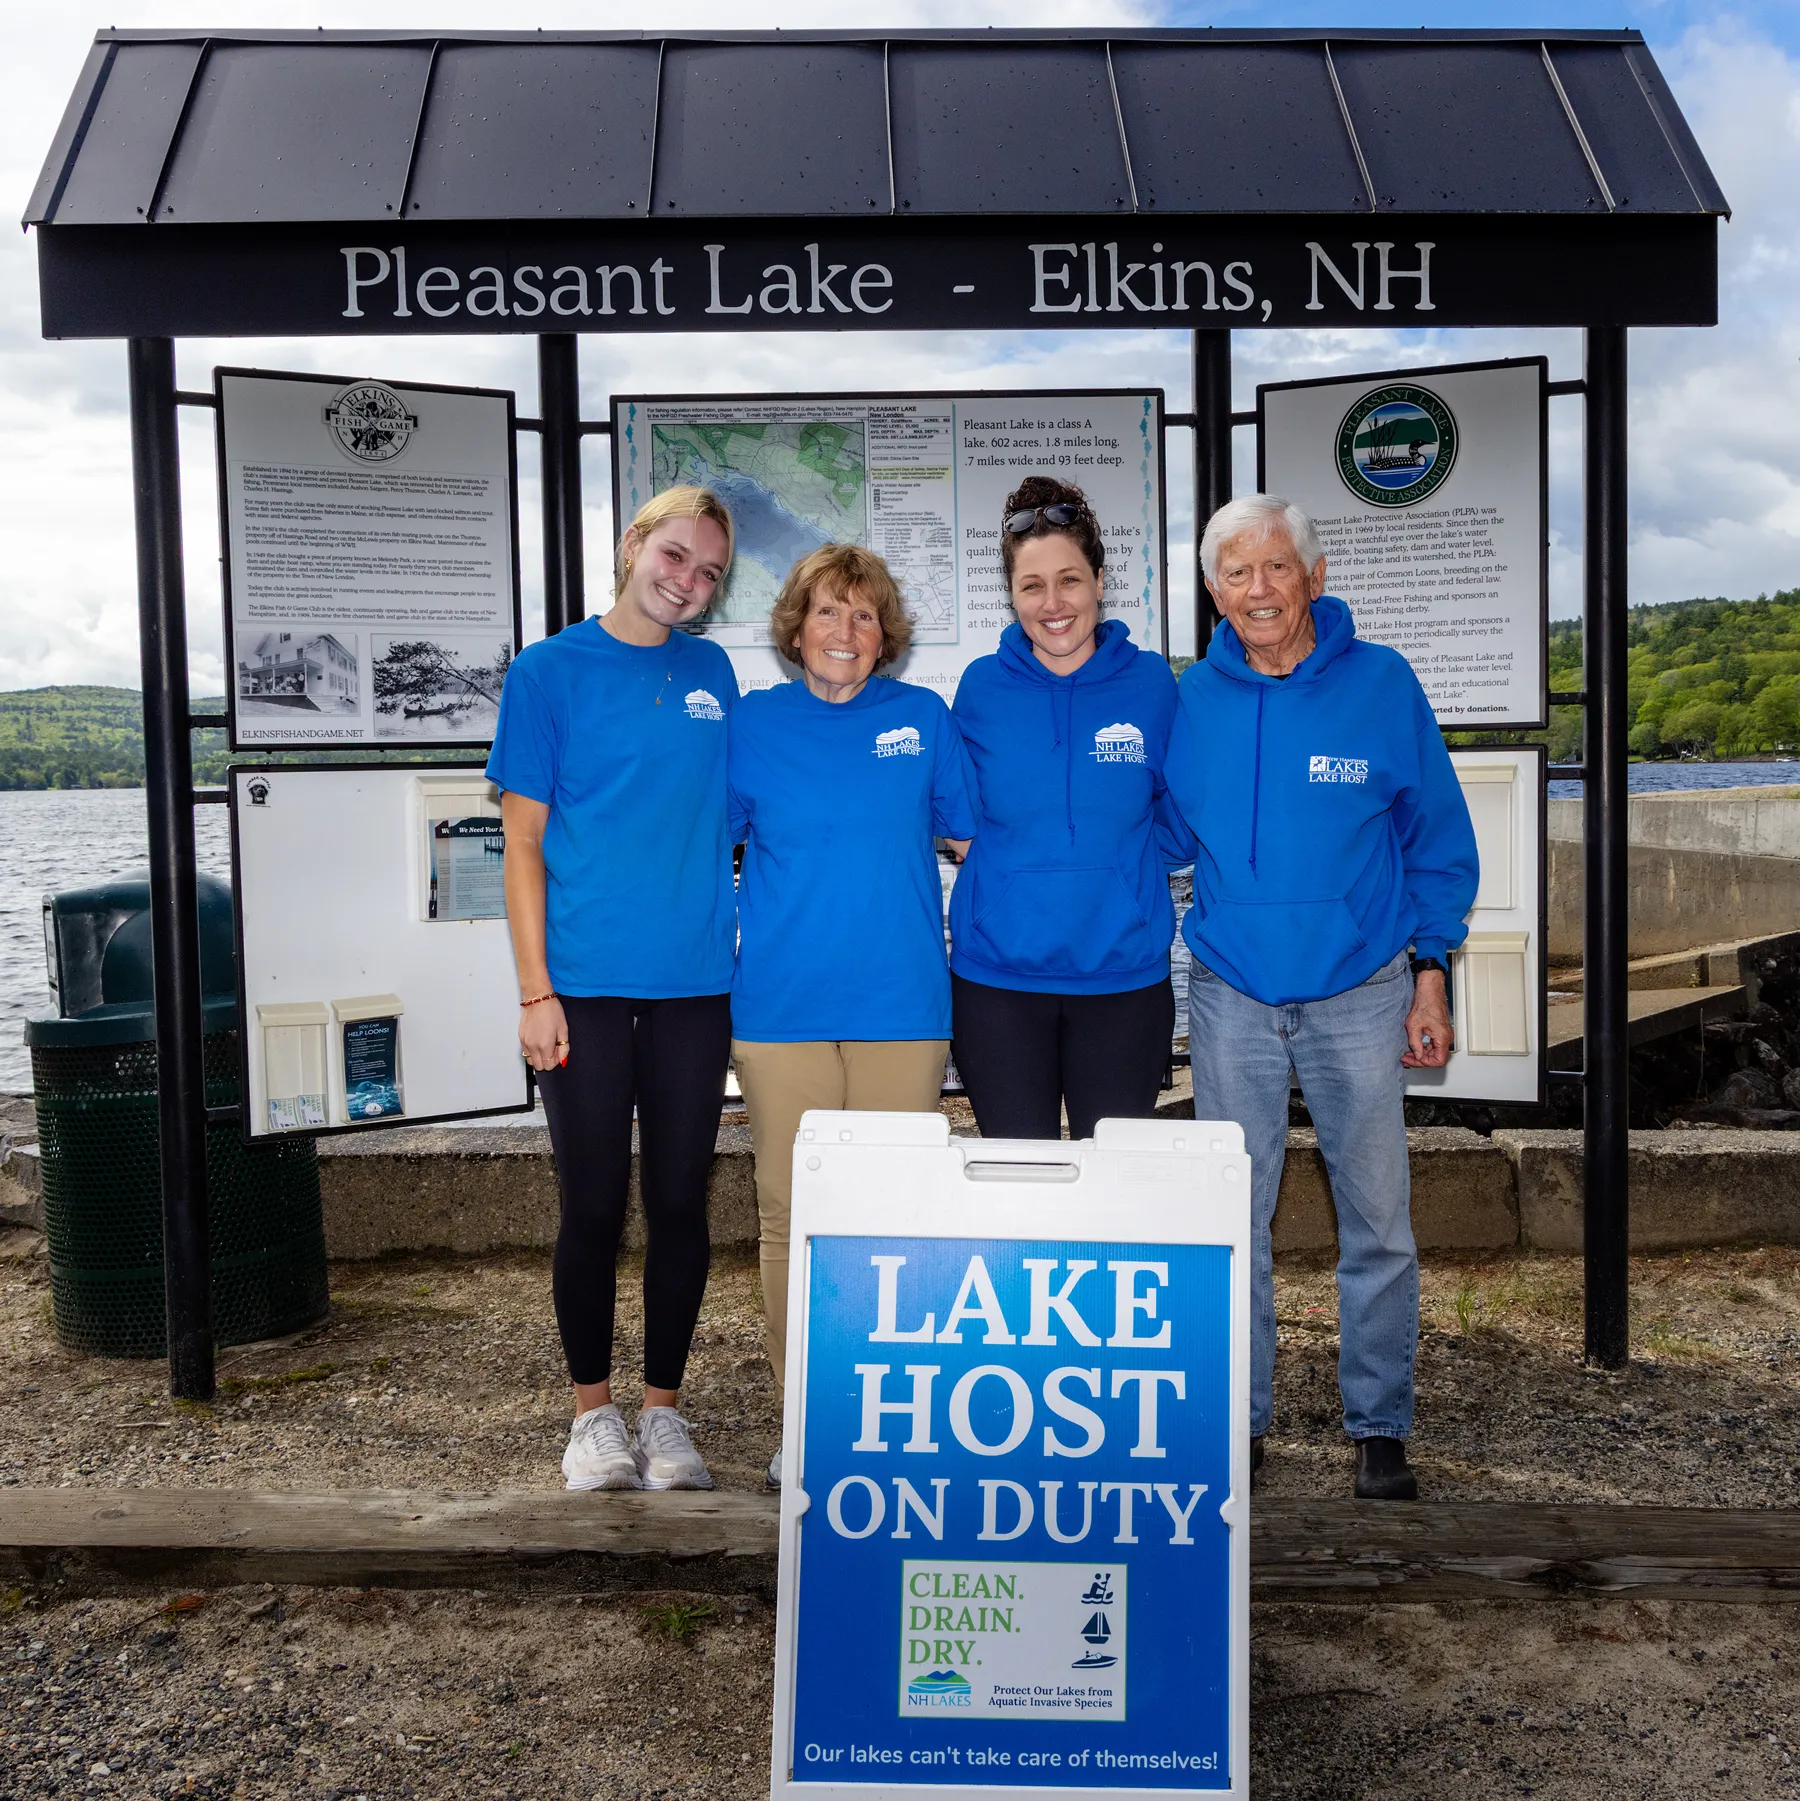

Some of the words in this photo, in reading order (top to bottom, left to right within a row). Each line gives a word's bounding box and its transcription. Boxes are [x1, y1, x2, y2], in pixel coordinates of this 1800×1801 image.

[340, 247, 675, 317] Pleasant
[704, 244, 893, 314] Lake
[1028, 243, 1273, 322] Elkins,
[1305, 242, 1436, 310] NH
[346, 390, 395, 407] ELKINS
[1344, 389, 1412, 435] PLEASANT
[1418, 395, 1449, 429] LAKE
[335, 418, 362, 427] FISH
[380, 421, 411, 431] GAME
[963, 418, 1007, 430] Pleasant
[1009, 418, 1034, 429] Lake
[1037, 419, 1046, 429] is
[1048, 421, 1054, 429] a
[1056, 418, 1081, 429] class
[1084, 419, 1092, 428] A
[990, 437, 1010, 448] 602
[1046, 437, 1061, 447] 1.8
[1063, 436, 1092, 447] miles
[964, 456, 974, 466] .7
[977, 455, 1005, 466] miles
[1007, 454, 1033, 465] wide
[1035, 454, 1056, 465] and
[1058, 455, 1071, 465] 93
[1074, 454, 1094, 465] feet
[1096, 454, 1124, 467] deep.
[1342, 456, 1396, 502] PROTECTIVE
[1396, 447, 1452, 502] ASSOCIATION
[1343, 515, 1362, 524] Lake
[1363, 513, 1403, 522] Protective
[1404, 510, 1450, 520] Association
[1451, 507, 1479, 517] (PLPA)
[966, 527, 998, 538] Please
[1111, 525, 1141, 536] lake's
[1318, 529, 1343, 537] orated
[1344, 526, 1352, 535] in
[1355, 525, 1374, 534] 1969
[1374, 524, 1385, 534] by
[1386, 523, 1405, 532] local
[1407, 521, 1444, 530] residents.
[1446, 520, 1468, 528] Since
[1470, 518, 1489, 526] then
[966, 546, 1003, 559] quality
[1120, 543, 1133, 557] by
[1353, 546, 1384, 555] boating
[1410, 543, 1429, 551] dam
[1430, 541, 1446, 550] and
[1472, 538, 1494, 547] level.
[967, 564, 1006, 577] prevent
[1116, 561, 1127, 572] of
[967, 582, 1010, 592] invasive
[1103, 579, 1129, 590] ackle
[1327, 583, 1351, 592] which
[1367, 580, 1405, 591] protected
[1406, 580, 1417, 589] by
[1417, 579, 1437, 587] state
[1438, 577, 1454, 585] and
[1455, 576, 1484, 584] federal
[1120, 597, 1140, 608] and
[967, 620, 977, 628] at
[980, 617, 997, 628] the
[1358, 622, 1372, 630] NH
[1373, 621, 1393, 629] Lake
[1394, 620, 1412, 628] Host
[1414, 620, 1448, 629] program
[1450, 618, 1466, 626] and
[1467, 617, 1503, 626] sponsors
[749, 678, 769, 689] pair
[915, 673, 946, 683] watch
[701, 704, 722, 713] LAKES
[1454, 705, 1465, 714] by
[708, 713, 723, 721] HOST
[241, 729, 365, 739] ELKINSFISHANDGAME.NET
[893, 740, 920, 749] LAKES
[1096, 742, 1114, 752] NH
[1116, 742, 1145, 755] LAKES
[878, 750, 900, 758] LAKE
[900, 748, 920, 756] HOST
[1096, 754, 1123, 763] LAKE
[1124, 754, 1146, 764] HOST
[1326, 761, 1369, 774] LAKES
[1309, 774, 1339, 783] LAKE
[1340, 774, 1368, 784] HOST
[868, 1255, 1172, 1349] LAKE
[852, 1363, 1186, 1458] HOST
[826, 1475, 951, 1541] ON
[976, 1479, 1209, 1545] DUTY
[909, 1572, 1024, 1599] CLEAN.
[908, 1606, 1020, 1632] DRAIN.
[907, 1639, 982, 1665] DRY.
[993, 1685, 1031, 1695] Protect
[1033, 1685, 1054, 1695] Our
[1056, 1686, 1085, 1696] Lakes
[1087, 1686, 1113, 1697] from
[908, 1694, 928, 1706] NH
[931, 1693, 971, 1706] LAKES
[988, 1696, 1027, 1708] Aquatic
[1030, 1697, 1072, 1707] Invasive
[1074, 1697, 1113, 1710] Species
[804, 1743, 844, 1762] Our
[850, 1744, 902, 1763] lakes
[909, 1746, 960, 1764] can't
[966, 1747, 1011, 1765] take
[1017, 1752, 1061, 1766] care
[1068, 1749, 1090, 1767] of
[1094, 1750, 1217, 1769] themselves!
